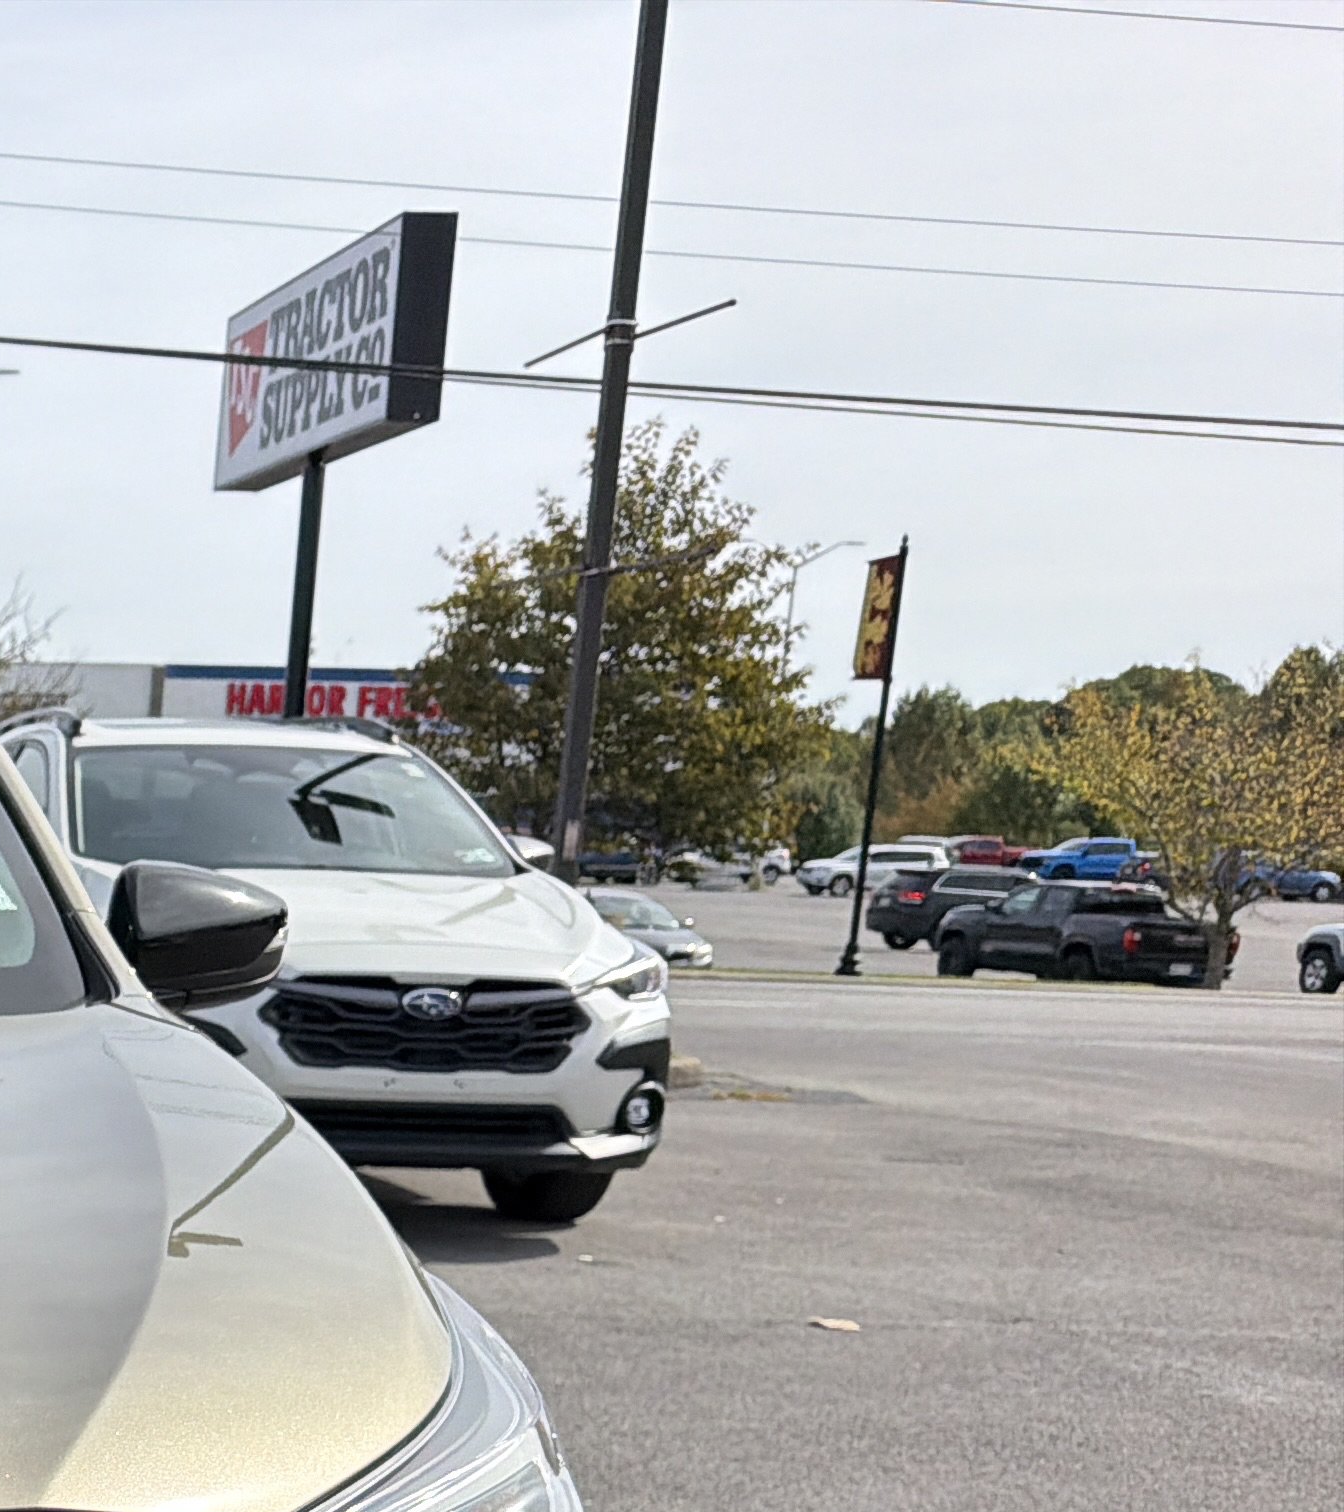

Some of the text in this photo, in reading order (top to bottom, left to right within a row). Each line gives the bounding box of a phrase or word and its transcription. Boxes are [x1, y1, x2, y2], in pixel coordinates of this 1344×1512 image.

[268, 245, 391, 373] TRACTOR
[259, 344, 352, 451] SUPPLY
[226, 682, 346, 717] HAROR
